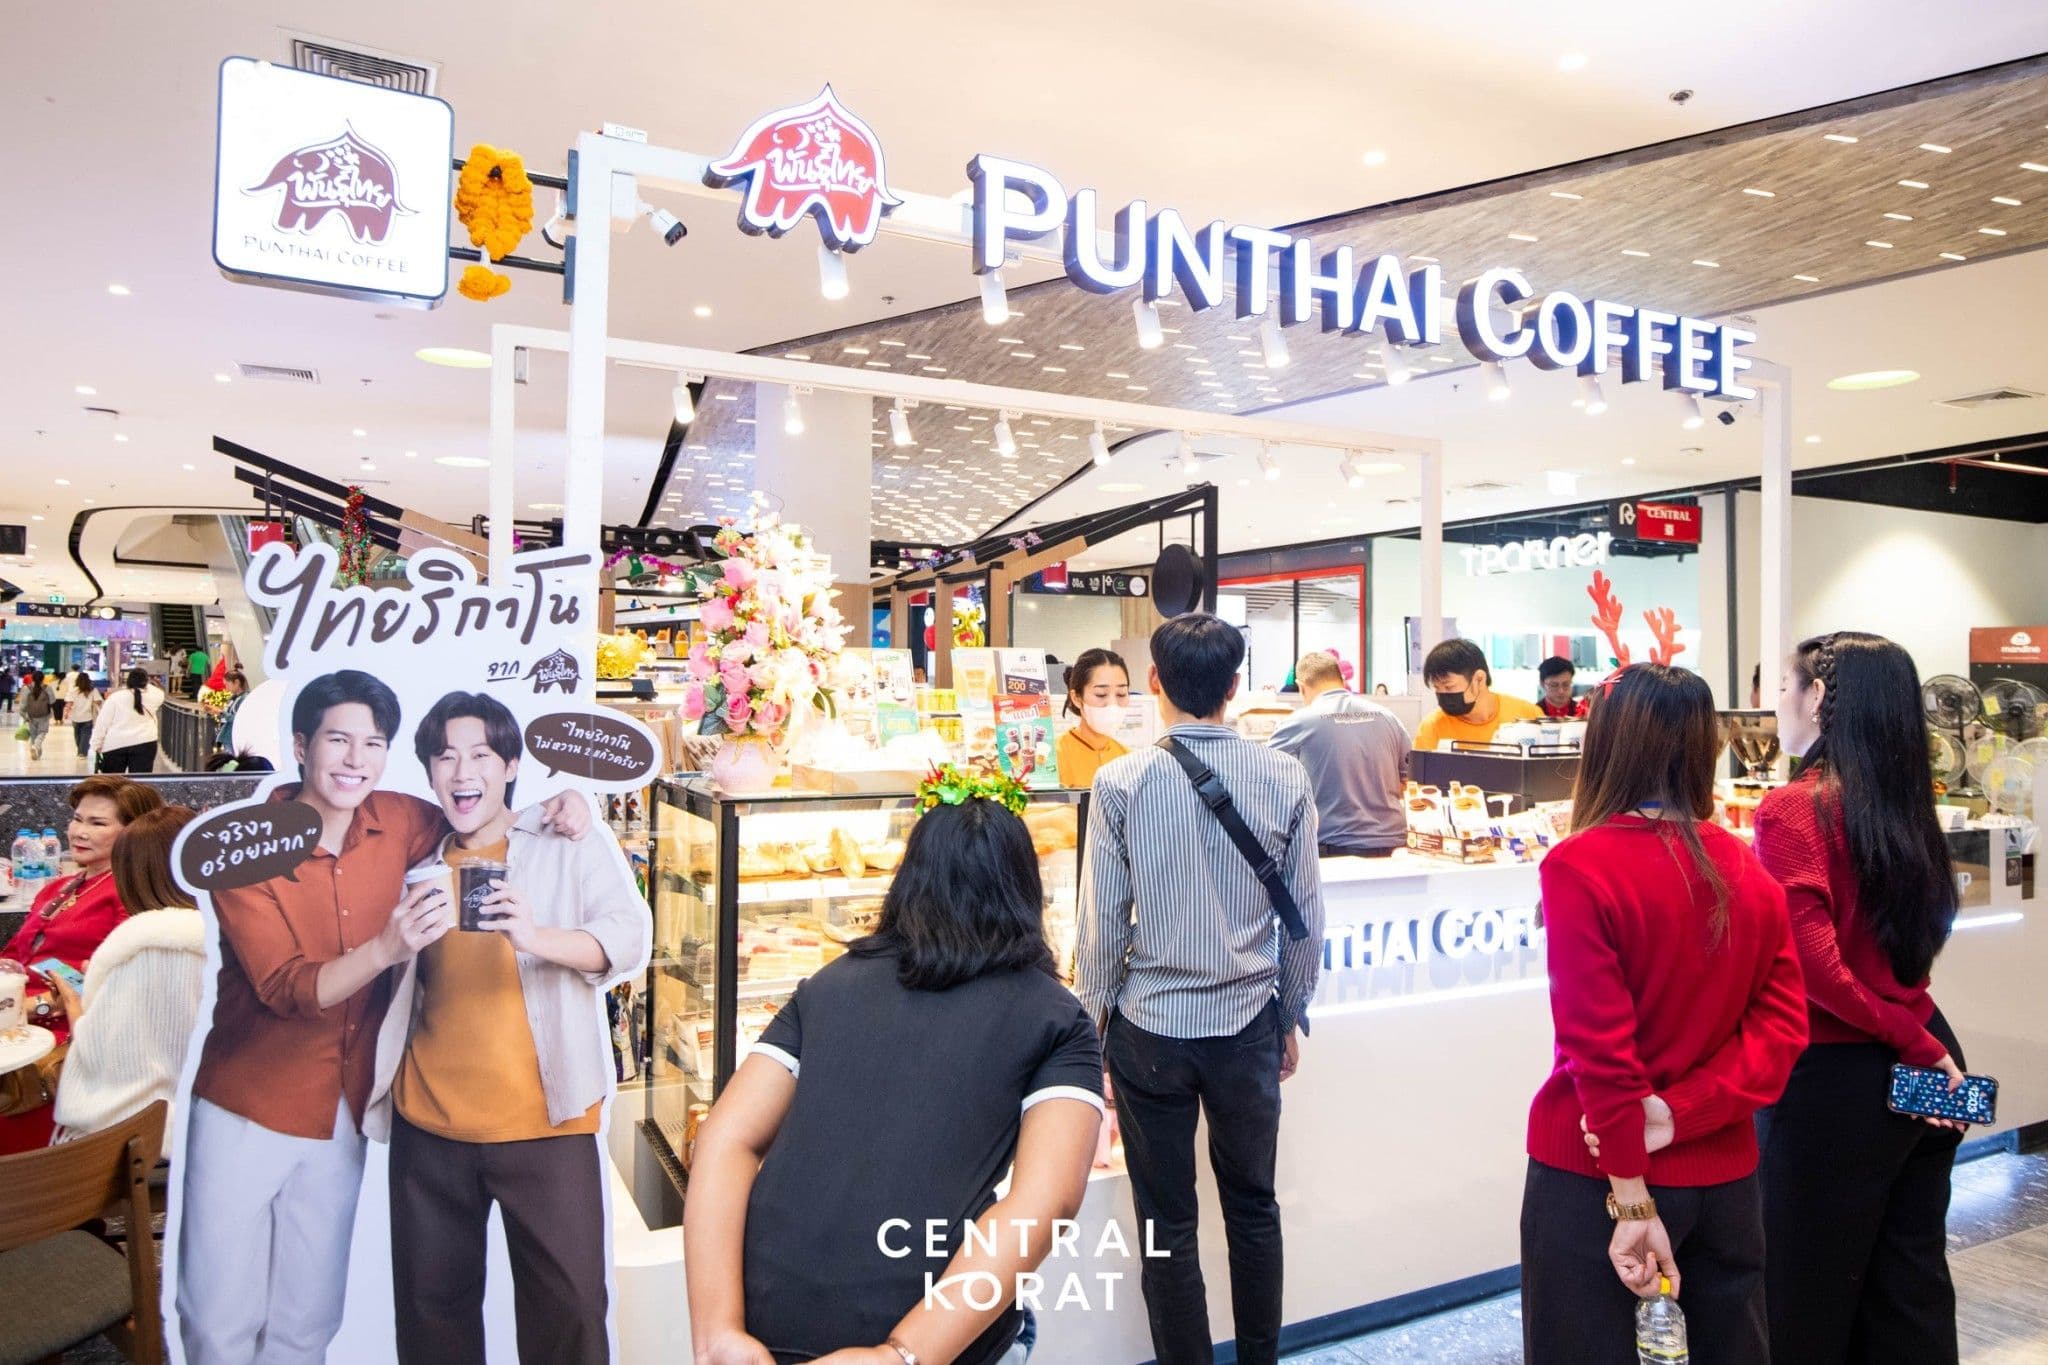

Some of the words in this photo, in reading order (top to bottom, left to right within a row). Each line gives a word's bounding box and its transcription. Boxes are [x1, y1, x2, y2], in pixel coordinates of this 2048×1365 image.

[244, 234, 329, 262] PUNTHAI
[337, 250, 409, 273] COFFEE
[967, 153, 1442, 346] PUNTHAI
[1456, 267, 1758, 400] COFFEE
[1646, 508, 1692, 522] CENTRAL
[257, 552, 592, 671] ไทยริกาโน
[487, 659, 521, 677] จาก
[1007, 680, 1026, 691] 200
[1323, 918, 1429, 974] THAI
